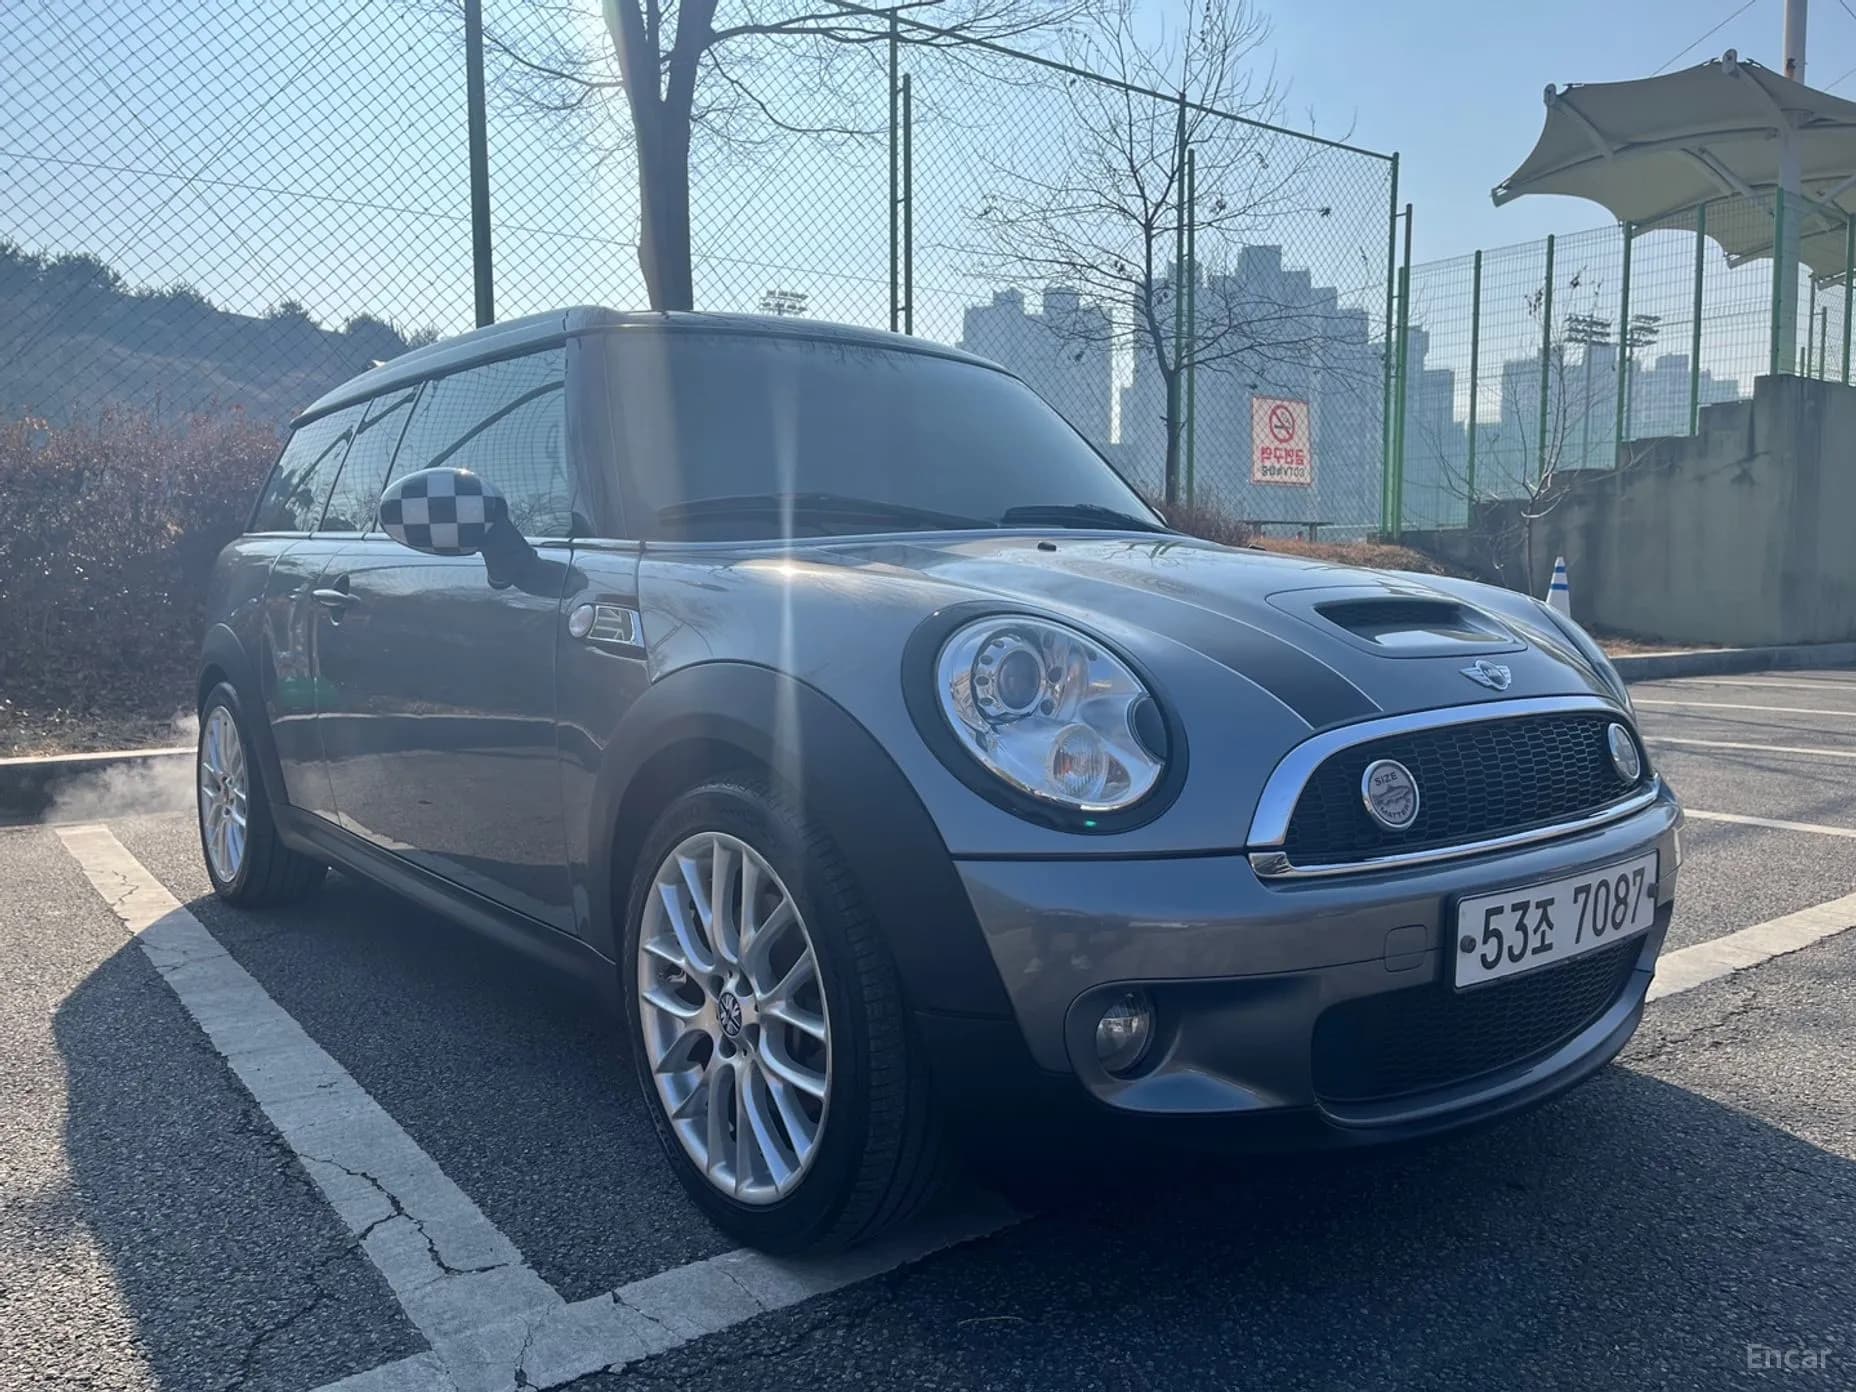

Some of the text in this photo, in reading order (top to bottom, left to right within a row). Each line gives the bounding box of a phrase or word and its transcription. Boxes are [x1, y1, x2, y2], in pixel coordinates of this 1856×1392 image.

[1374, 771, 1398, 786] SIZE
[1480, 867, 1645, 970] 53조 7087
